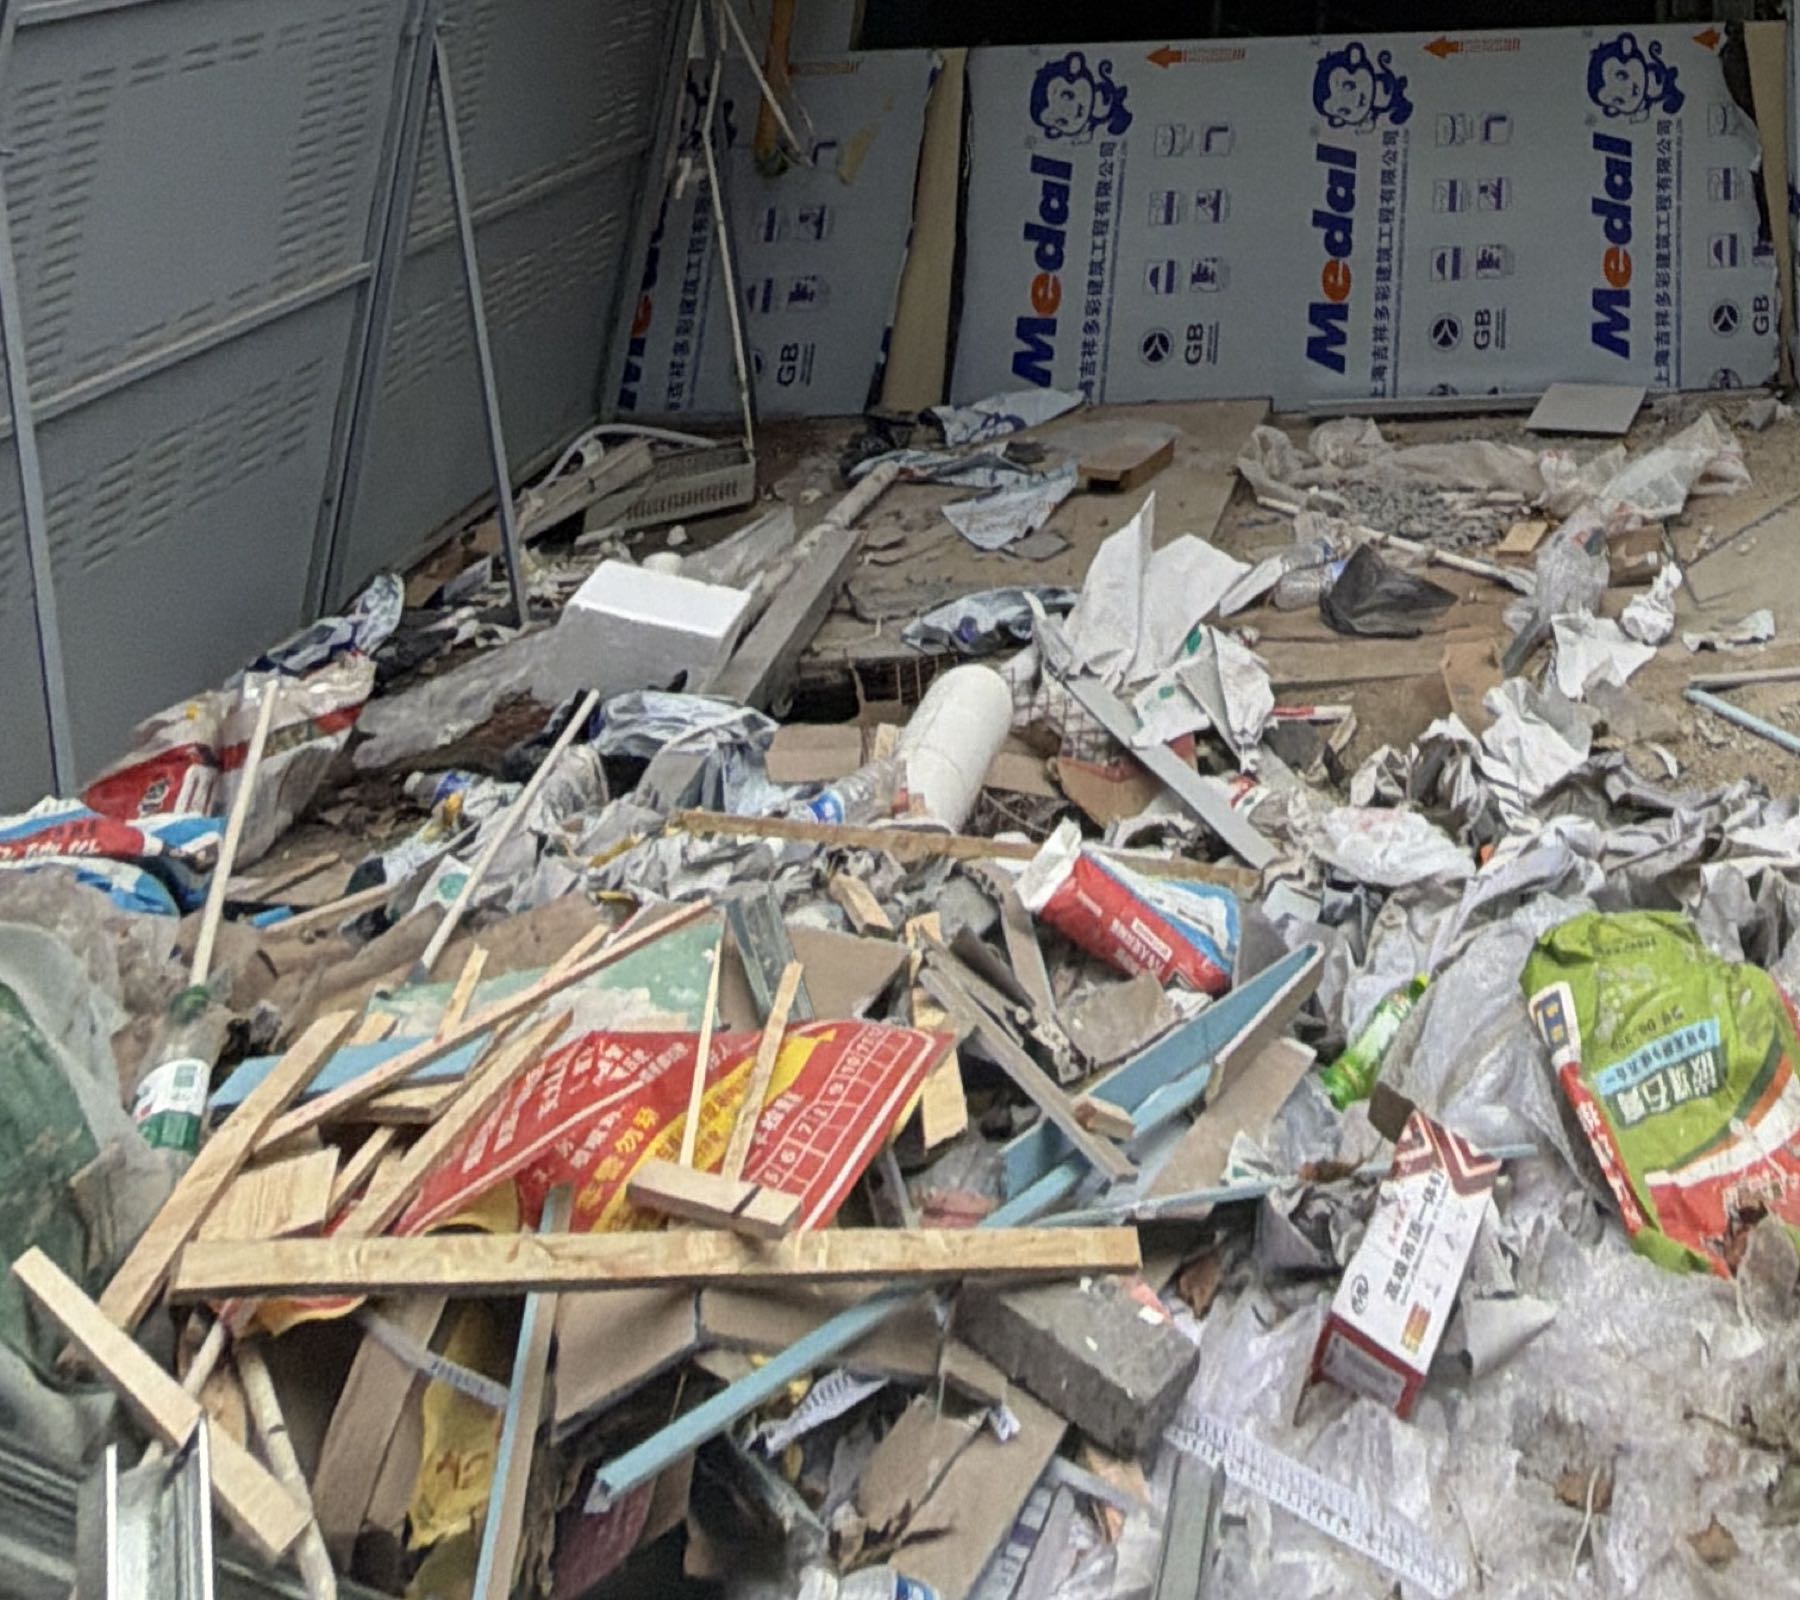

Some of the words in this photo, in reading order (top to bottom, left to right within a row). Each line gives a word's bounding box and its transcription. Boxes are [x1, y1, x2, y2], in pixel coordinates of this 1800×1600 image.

[1306, 143, 1357, 375] Medal
[1591, 132, 1633, 361] Medal
[1011, 153, 1073, 389] Medal
[1474, 308, 1491, 350] GB
[1752, 294, 1770, 337] GB
[777, 342, 799, 387] GB
[1184, 323, 1203, 366] GB
